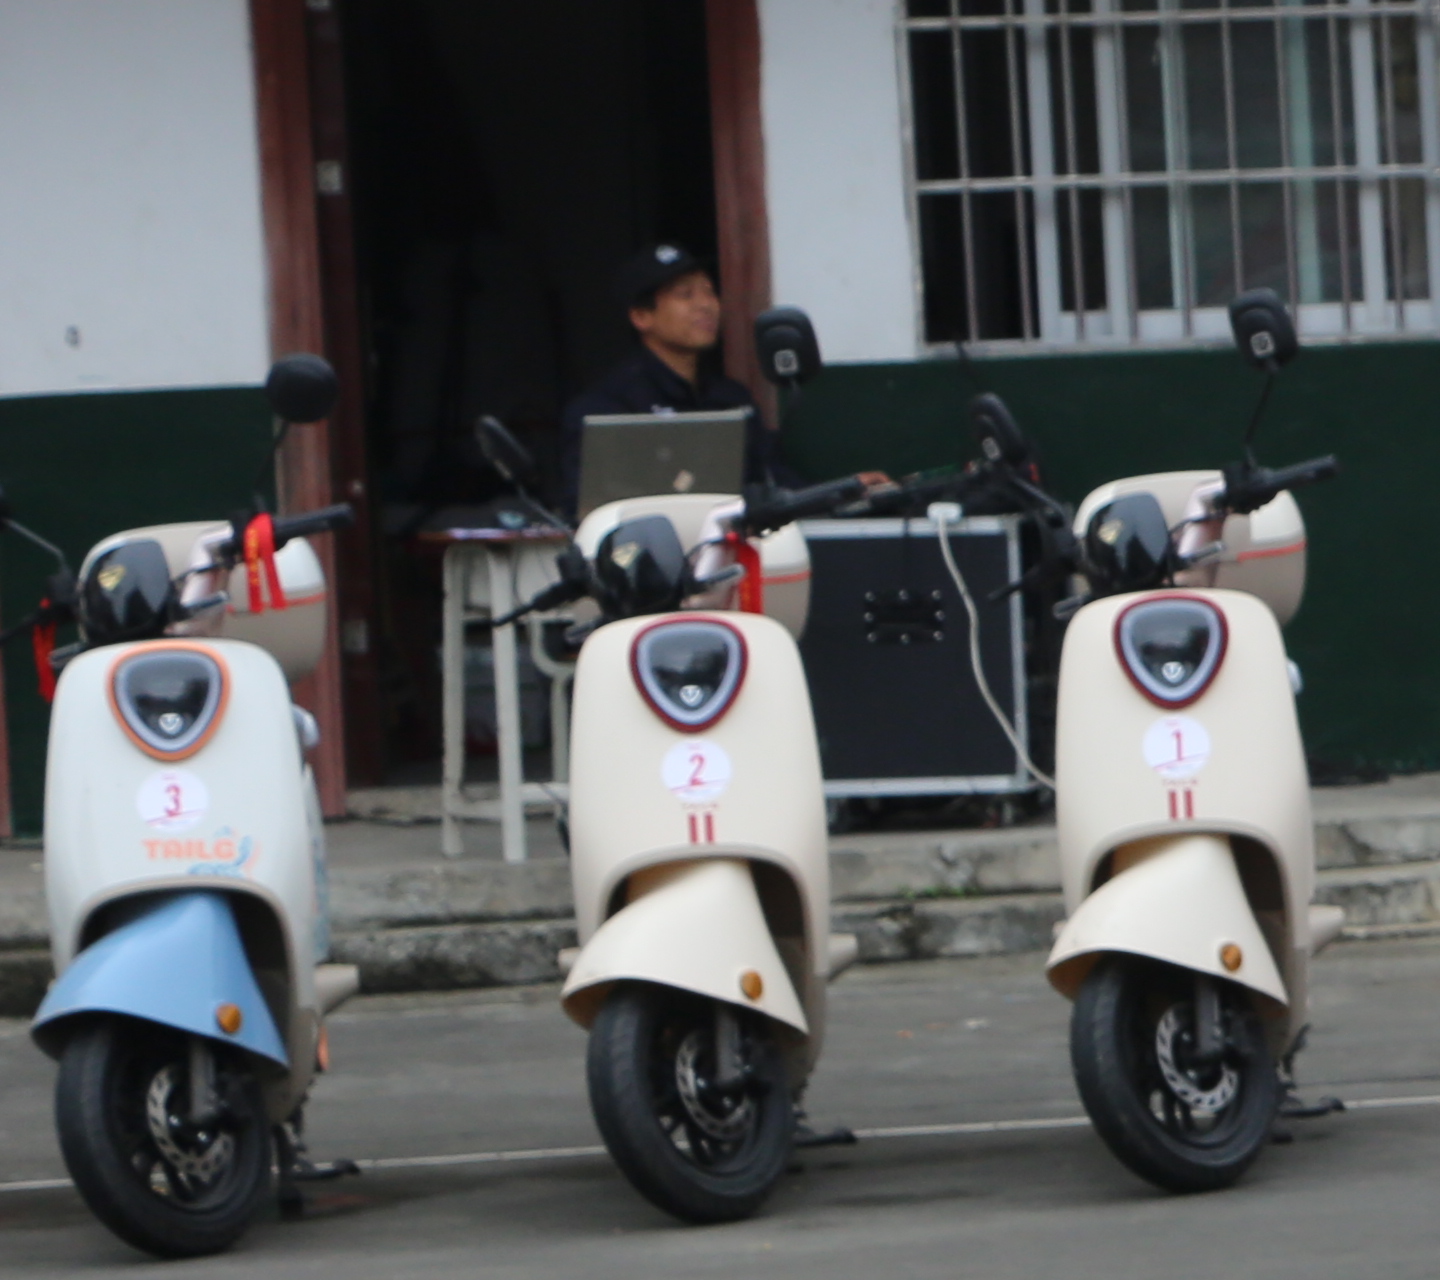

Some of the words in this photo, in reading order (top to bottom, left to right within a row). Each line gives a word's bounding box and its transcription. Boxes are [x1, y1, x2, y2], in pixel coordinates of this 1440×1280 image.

[1171, 728, 1183, 761] 1
[689, 752, 705, 786] 2
[163, 783, 182, 818] 3
[141, 837, 239, 862] TAILG
